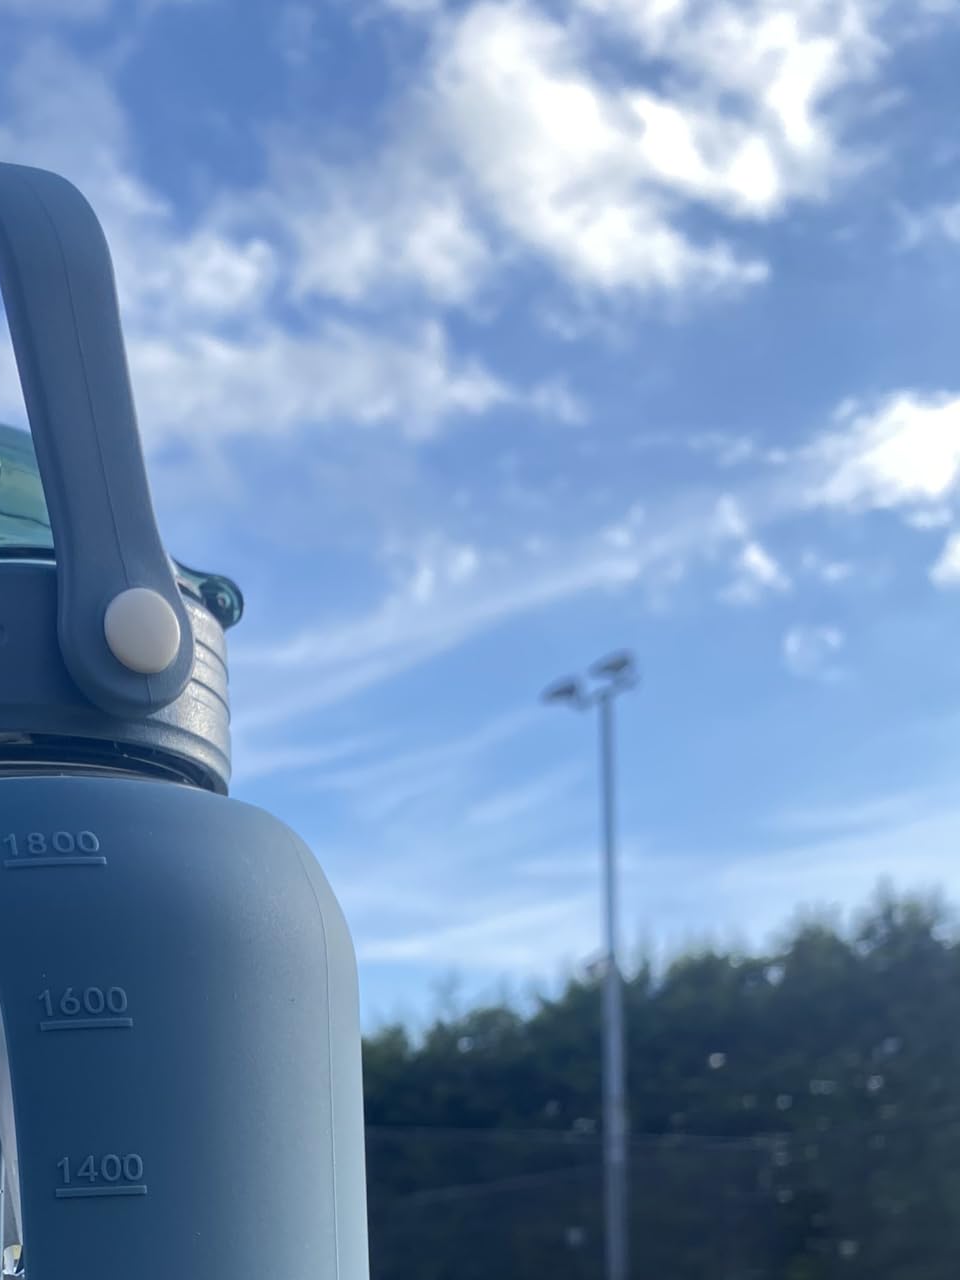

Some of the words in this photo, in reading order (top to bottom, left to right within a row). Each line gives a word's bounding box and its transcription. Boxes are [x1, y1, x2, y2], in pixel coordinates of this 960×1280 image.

[3, 830, 100, 857] 1800
[37, 986, 128, 1017] 1600
[56, 1153, 144, 1184] 1400
